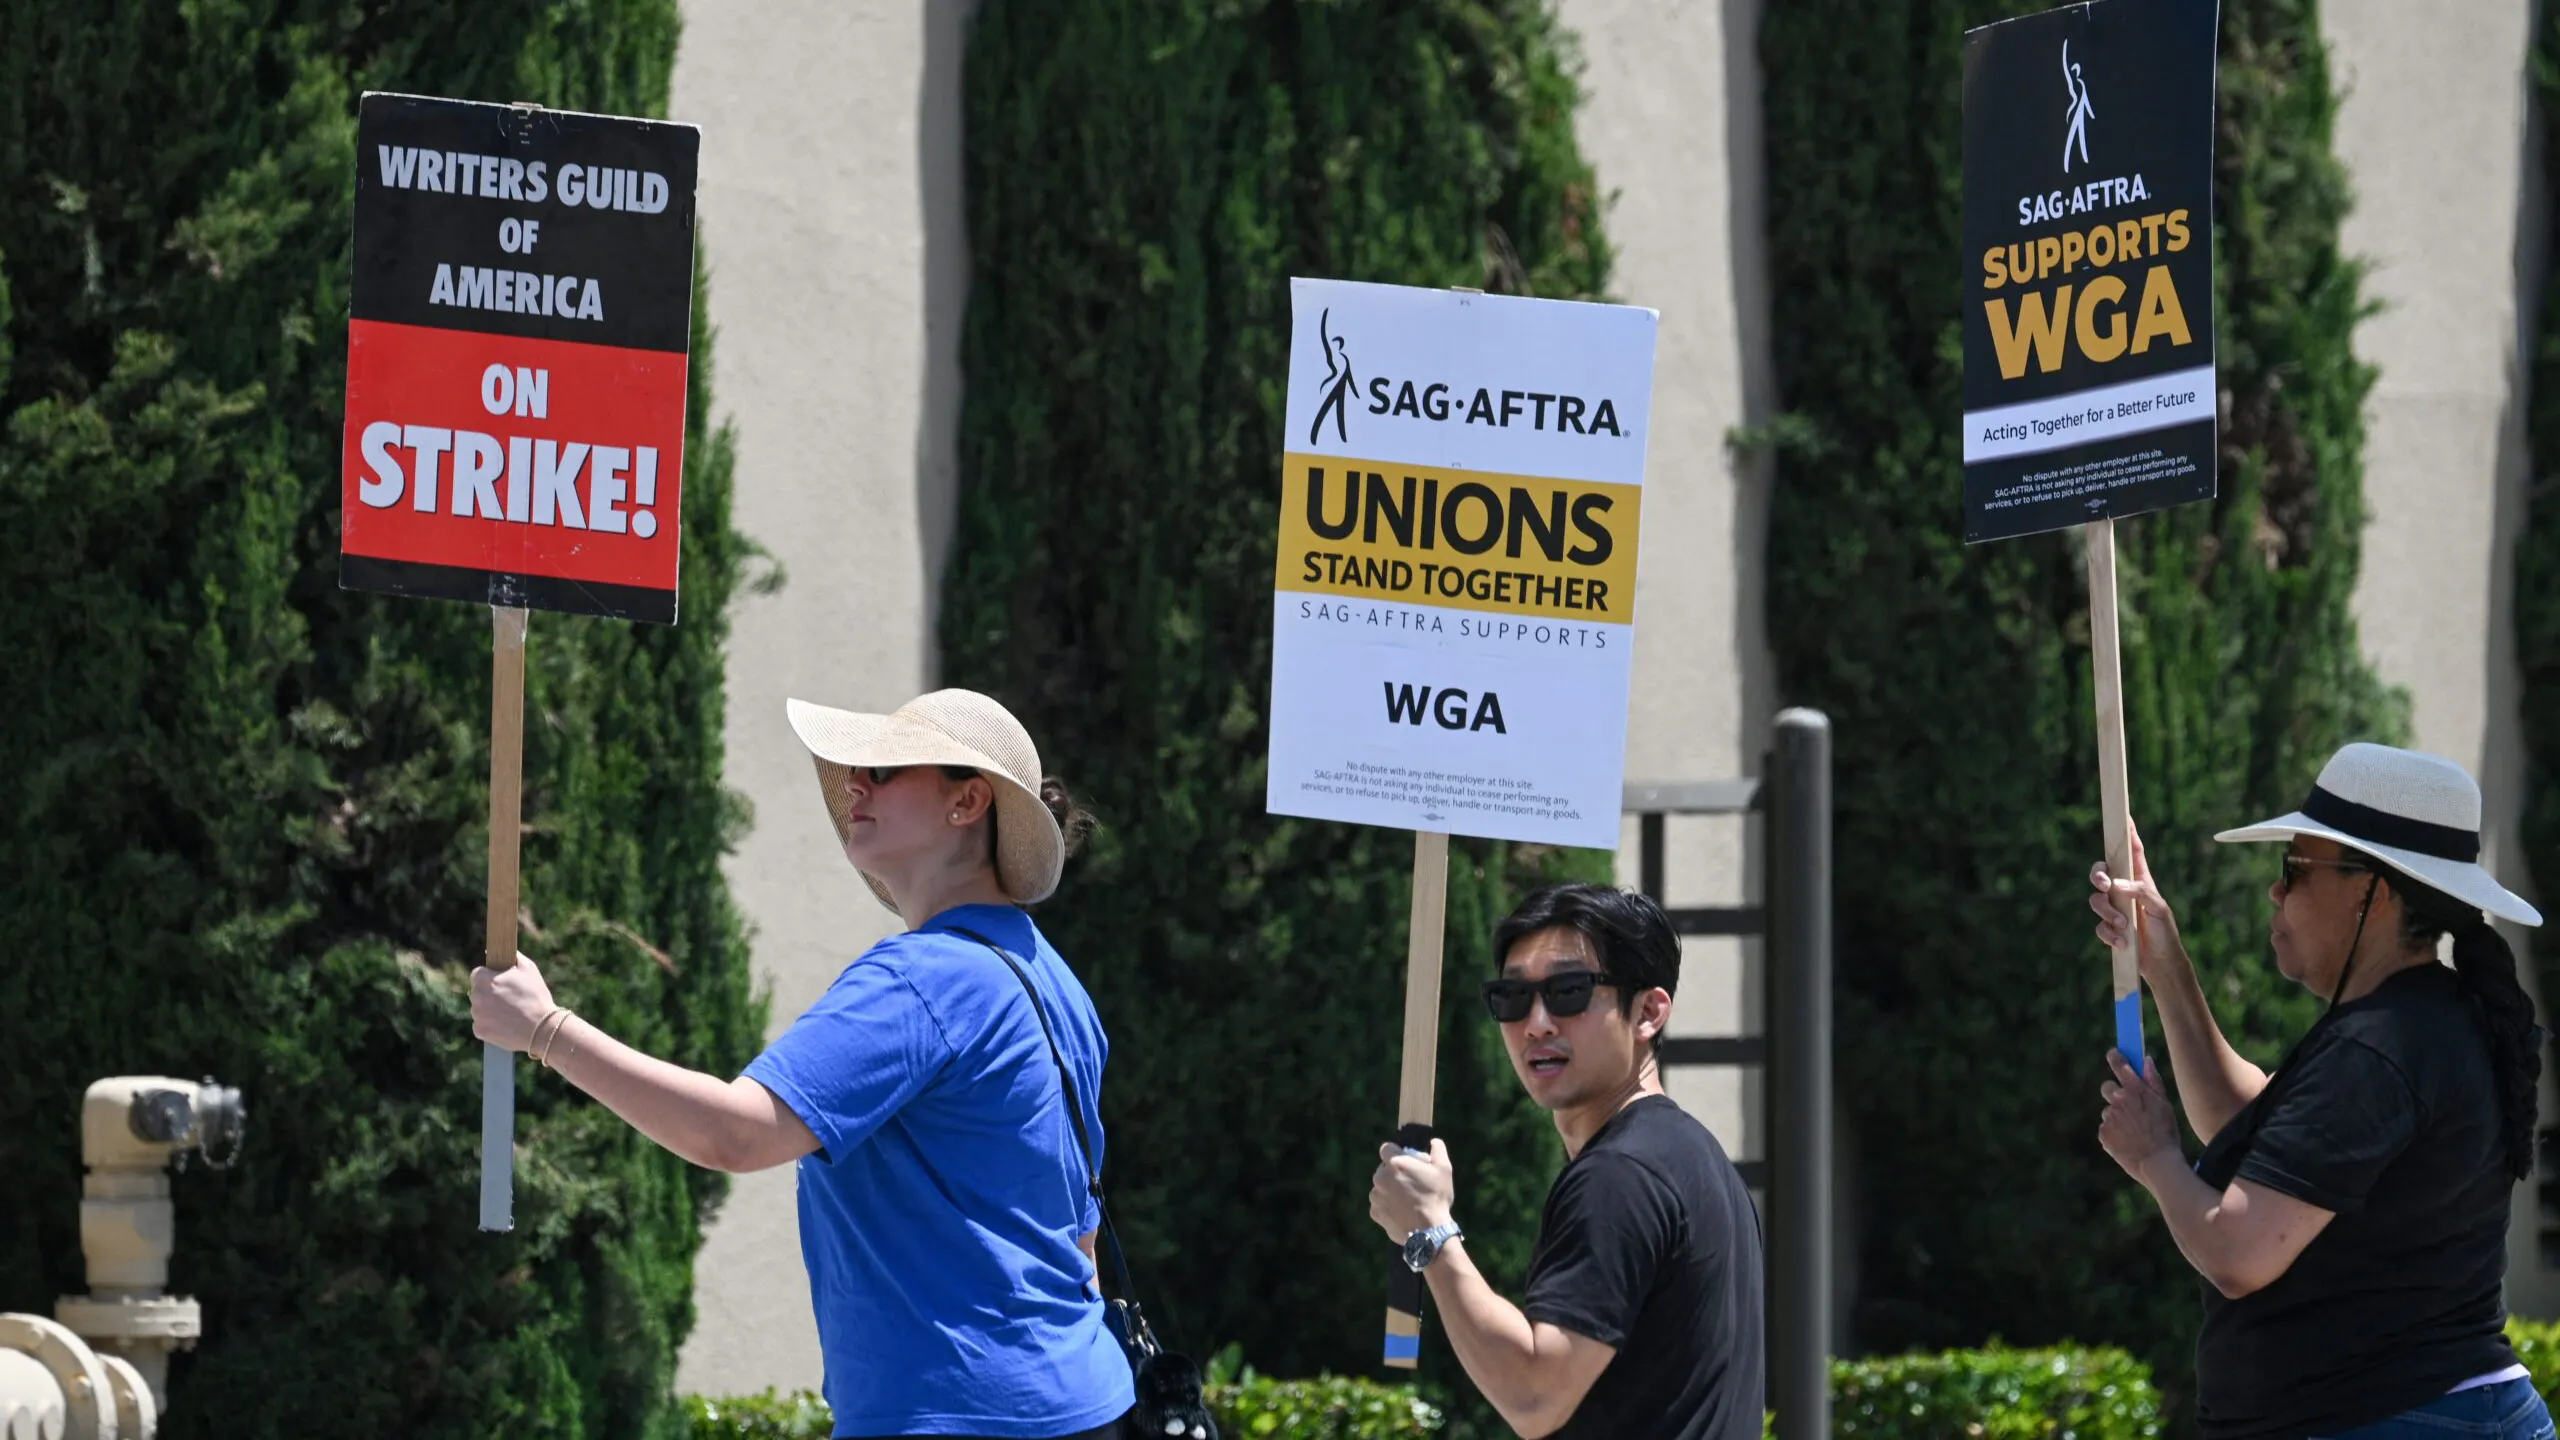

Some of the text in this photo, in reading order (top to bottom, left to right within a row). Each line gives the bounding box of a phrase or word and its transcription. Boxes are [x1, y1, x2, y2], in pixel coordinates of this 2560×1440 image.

[378, 144, 669, 215] WRITERS GUILD
[499, 217, 539, 255] OF
[1983, 209, 2191, 289] SUPPORTS
[429, 263, 603, 322] AMERICA
[1984, 264, 2192, 381] WGA
[481, 363, 549, 420] ON
[1983, 391, 2195, 443] Acting Together for a Better Future
[359, 421, 659, 539] STRIKE!
[2014, 497, 2022, 506] or
[2023, 496, 2031, 504] to
[2032, 492, 2053, 502] refuse
[2053, 490, 2061, 499] to
[2061, 487, 2074, 499] pick
[2108, 478, 2129, 488] handle
[2129, 476, 2137, 484] or
[2137, 470, 2165, 482] transport
[2165, 468, 2176, 477] any
[2022, 474, 2033, 483] No
[2034, 470, 2059, 481] dispute
[2059, 467, 2073, 477] with
[2073, 466, 2085, 474] any
[2085, 461, 2102, 471] other
[2102, 456, 2131, 467] employer
[2132, 453, 2138, 462] at
[2138, 451, 2150, 460] this
[2035, 483, 2041, 492] is
[2042, 482, 2053, 490] not
[2055, 478, 2075, 487] asking
[2075, 475, 2086, 484] any
[2086, 468, 2117, 481] individual
[2125, 464, 2142, 474] cease
[2143, 456, 2176, 472] performing
[2177, 454, 2188, 464] any
[1306, 466, 1615, 567] UNIONS
[1303, 551, 1609, 612] STAND TOGETHER
[1300, 601, 1607, 649] SAG-AFTRA SUPPORTS
[1384, 681, 1507, 735] WGA
[1346, 760, 1358, 772] No
[1359, 762, 1388, 775] dispute
[1389, 766, 1407, 777] with
[1408, 769, 1421, 780] any
[1423, 771, 1445, 780] other
[1447, 773, 1485, 785] employer
[1488, 777, 1496, 787] at
[1498, 778, 1515, 789] this
[1361, 774, 1368, 785] is
[1369, 777, 1382, 787] not
[1383, 778, 1408, 792] asking
[1409, 782, 1423, 794] any
[1425, 782, 1465, 796] individual
[1467, 787, 1476, 797] to
[1478, 790, 1501, 799] cease
[1503, 791, 1552, 807] performing
[1553, 796, 1569, 808] any
[1335, 786, 1345, 794] or
[1345, 785, 1354, 796] to
[1355, 787, 1380, 799] refuse
[1381, 790, 1389, 800] to
[1390, 791, 1406, 802] pick
[1422, 794, 1450, 808] deliver,
[1452, 797, 1481, 810] handle
[1482, 802, 1492, 811] or
[1493, 803, 1534, 816] transport
[1535, 808, 1551, 818] any
[1553, 808, 1582, 821] goods.
